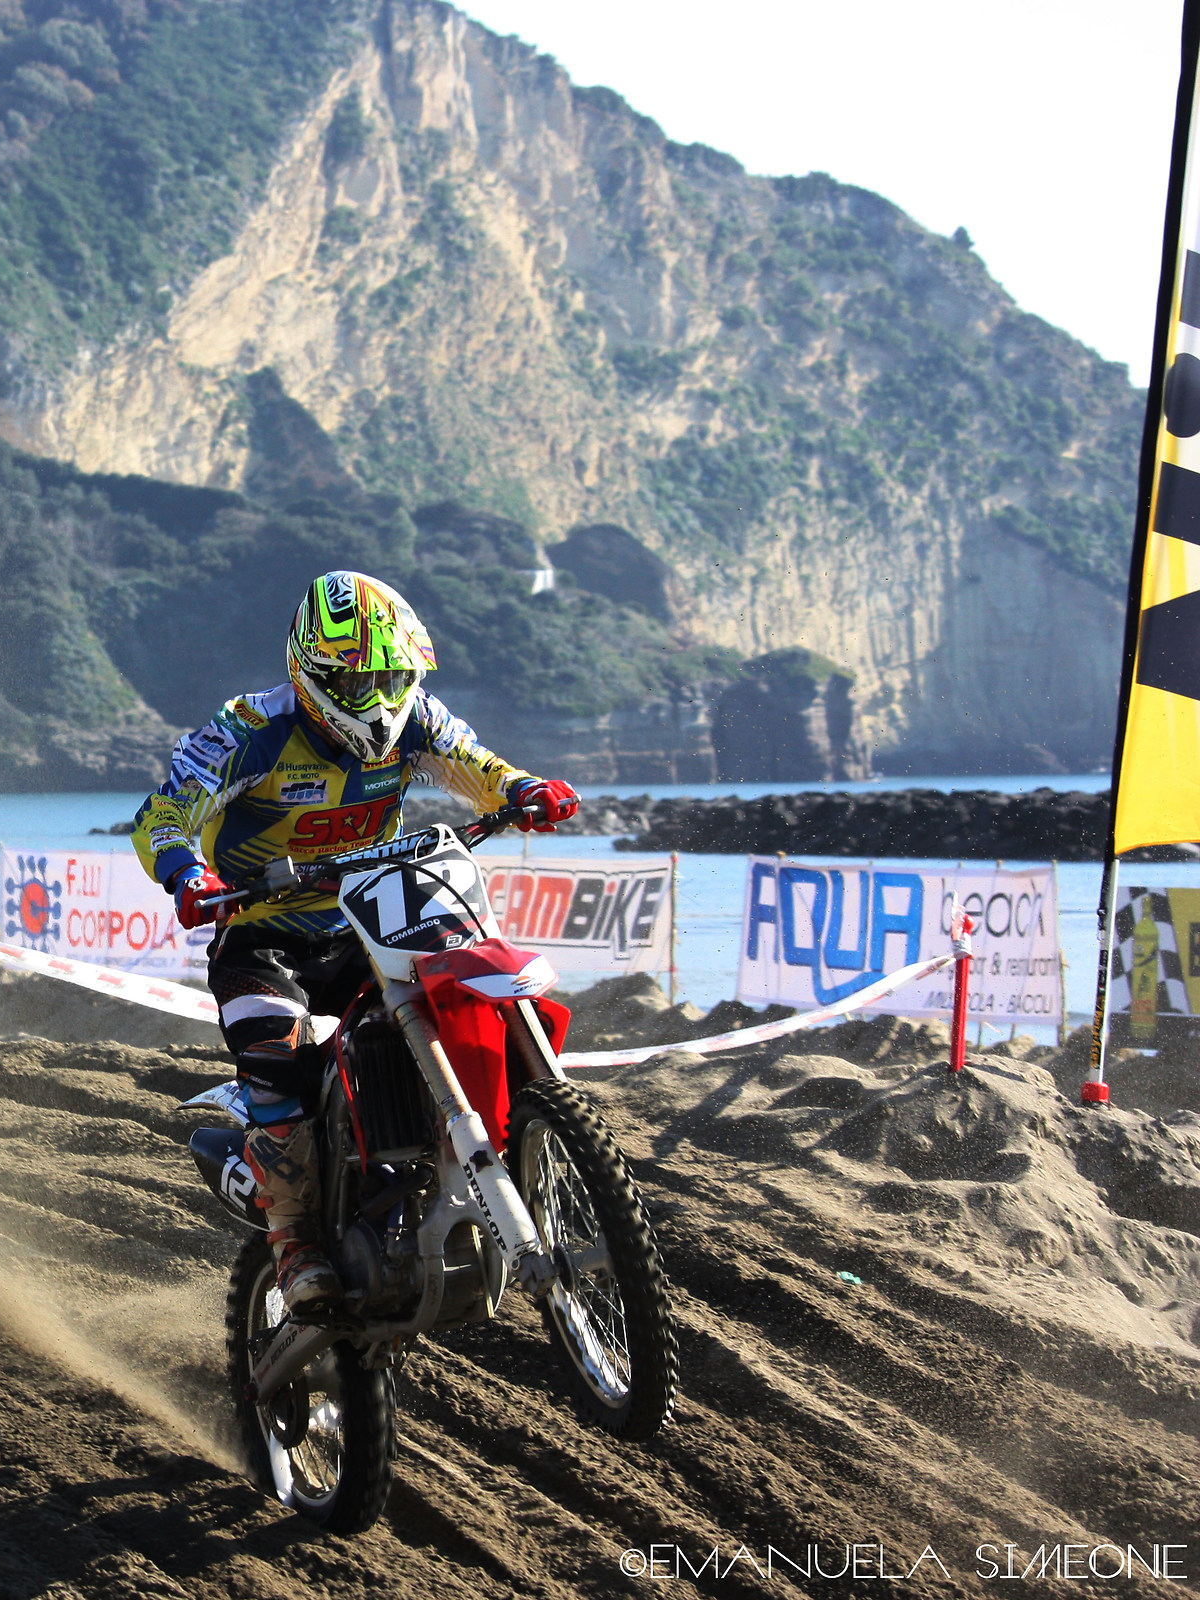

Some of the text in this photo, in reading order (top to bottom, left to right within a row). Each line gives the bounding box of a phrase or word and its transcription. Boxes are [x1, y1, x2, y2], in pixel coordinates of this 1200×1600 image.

[287, 792, 399, 846] SRT
[350, 839, 373, 848] Team
[363, 859, 481, 938] 12
[67, 907, 178, 951] COPPOLA
[386, 918, 440, 945] LOMBARDO
[748, 863, 923, 1005] AQUA
[463, 1163, 508, 1253] DUNLOP
